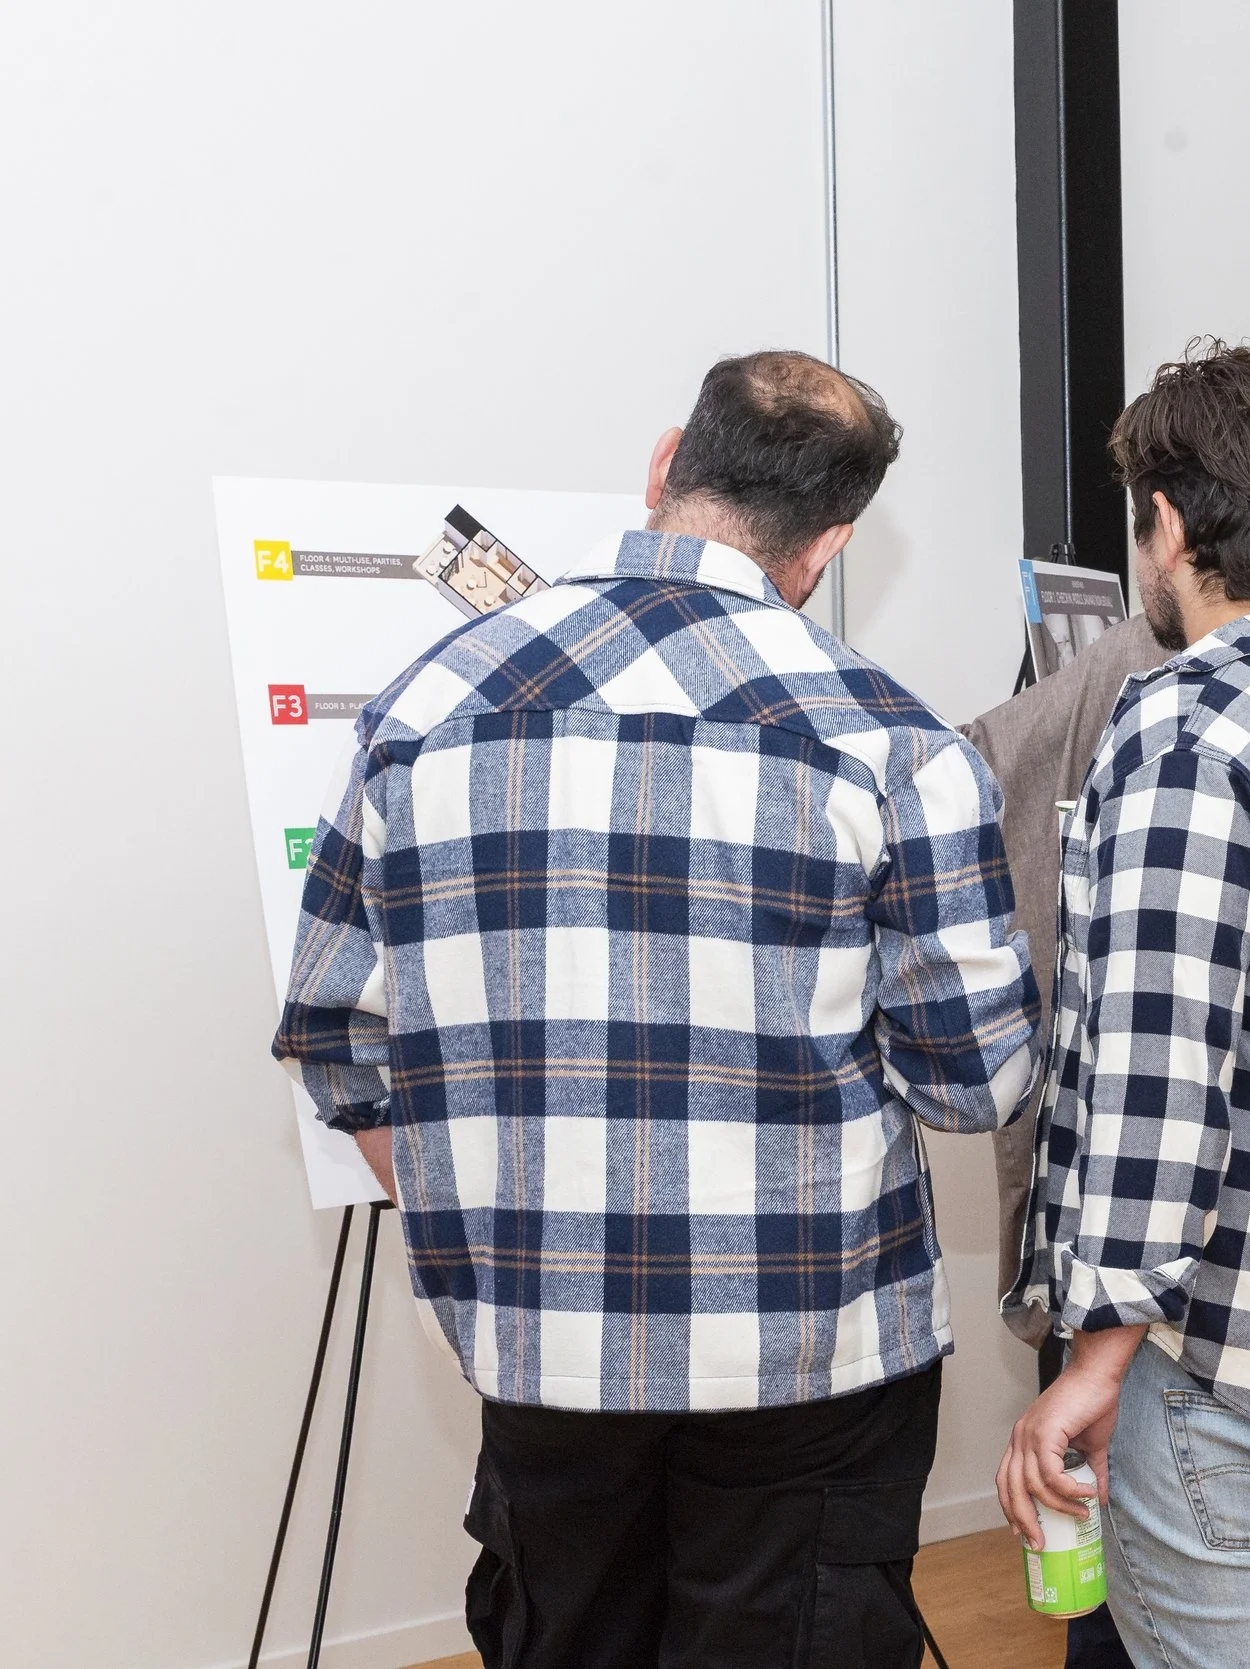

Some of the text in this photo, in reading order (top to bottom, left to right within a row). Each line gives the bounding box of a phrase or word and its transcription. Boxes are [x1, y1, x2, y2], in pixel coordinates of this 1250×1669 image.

[257, 550, 289, 573] F4
[300, 554, 325, 563] FLOOR
[333, 556, 372, 565] MULTI-USE,
[373, 557, 403, 567] PARTIES,
[300, 564, 380, 574] CLASSES, WORKSHOPS
[272, 695, 303, 718] F3
[315, 702, 339, 710] FLOOR
[289, 838, 314, 861] F
